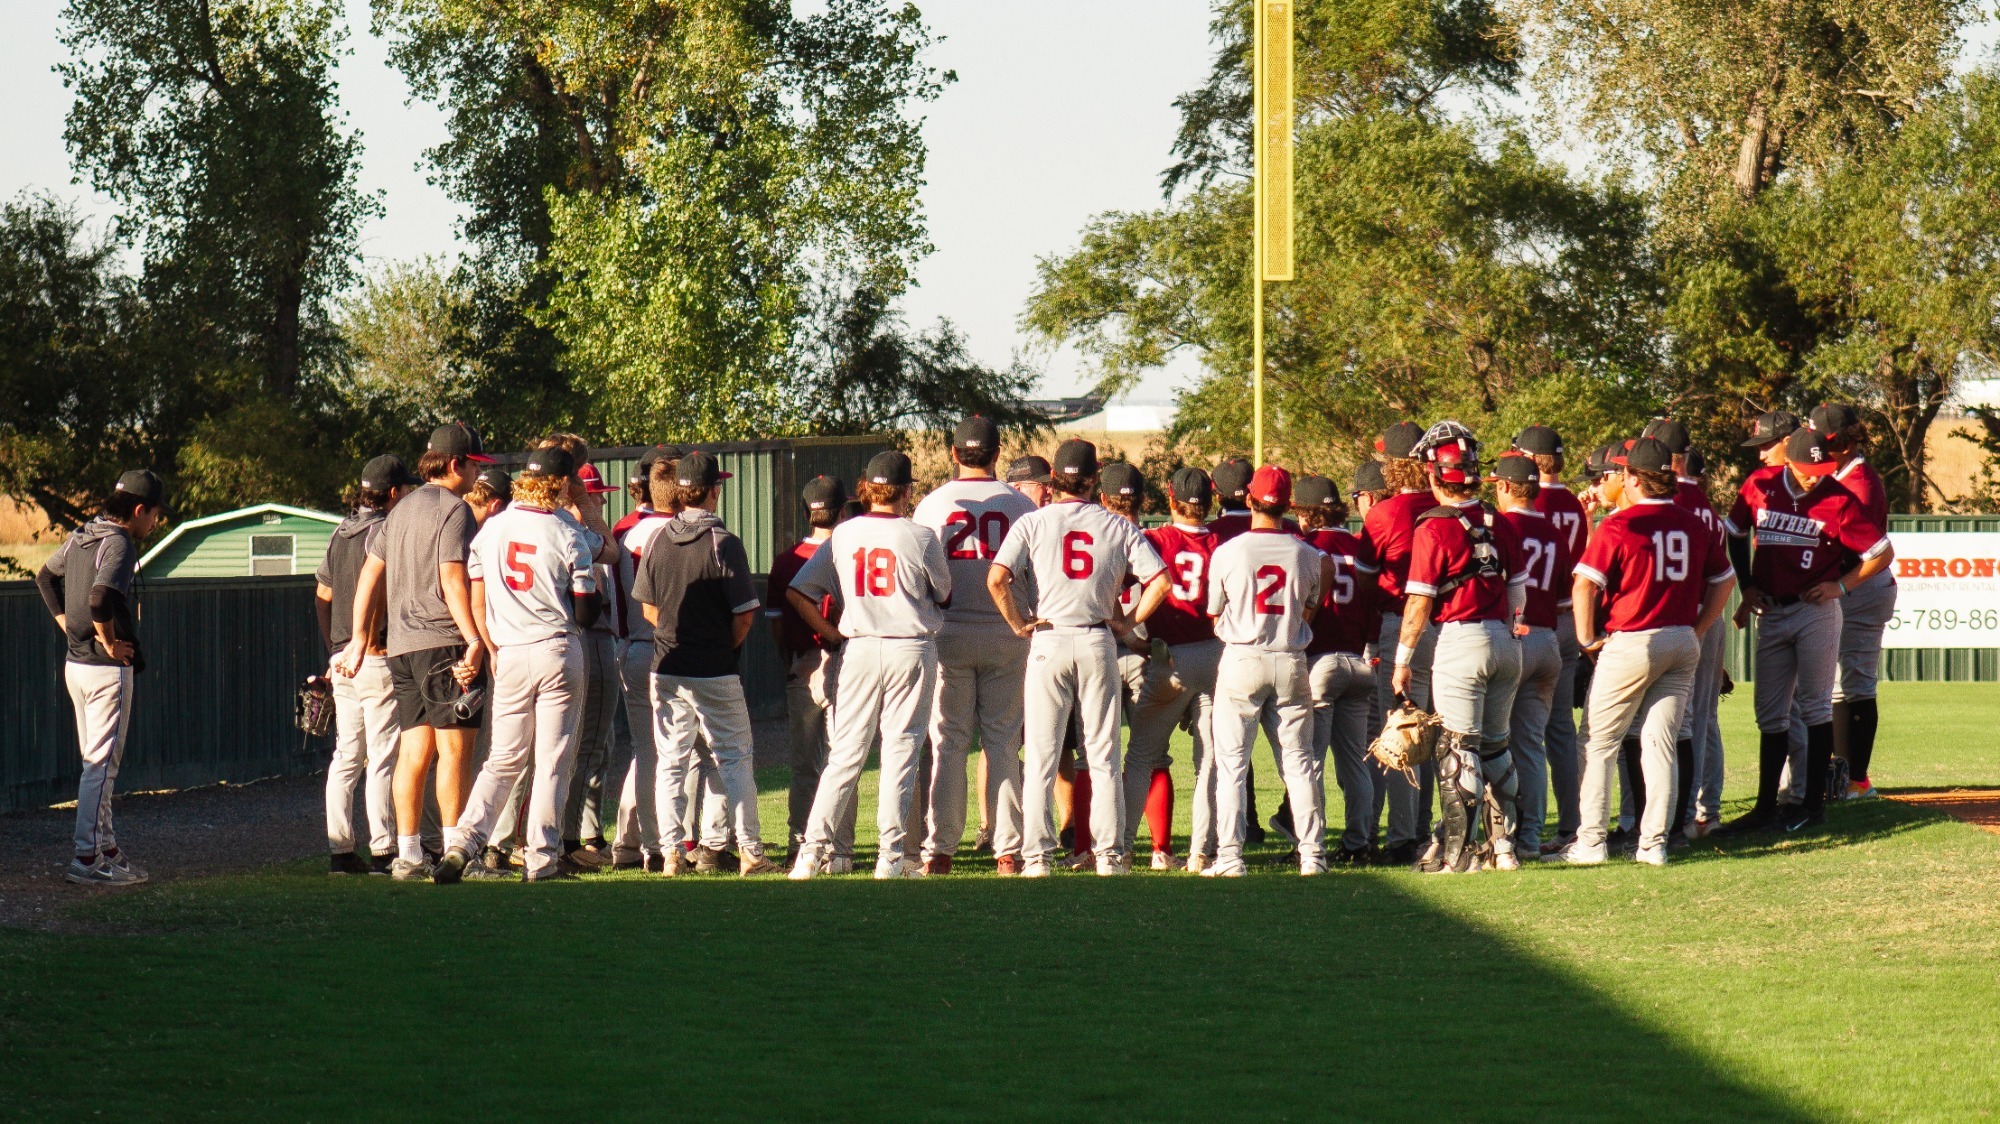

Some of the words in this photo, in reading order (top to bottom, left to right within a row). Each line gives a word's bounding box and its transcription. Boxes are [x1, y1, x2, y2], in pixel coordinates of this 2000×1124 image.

[946, 510, 1010, 560] 20
[1062, 530, 1094, 580] 6
[1652, 531, 1689, 581] 19
[1800, 549, 1814, 569] 9
[505, 541, 537, 592] 5
[853, 547, 897, 597] 18
[1172, 551, 1204, 602] 3
[1254, 564, 1287, 615] 2
[1522, 537, 1556, 592] 21
[1895, 558, 2000, 578] BRON
